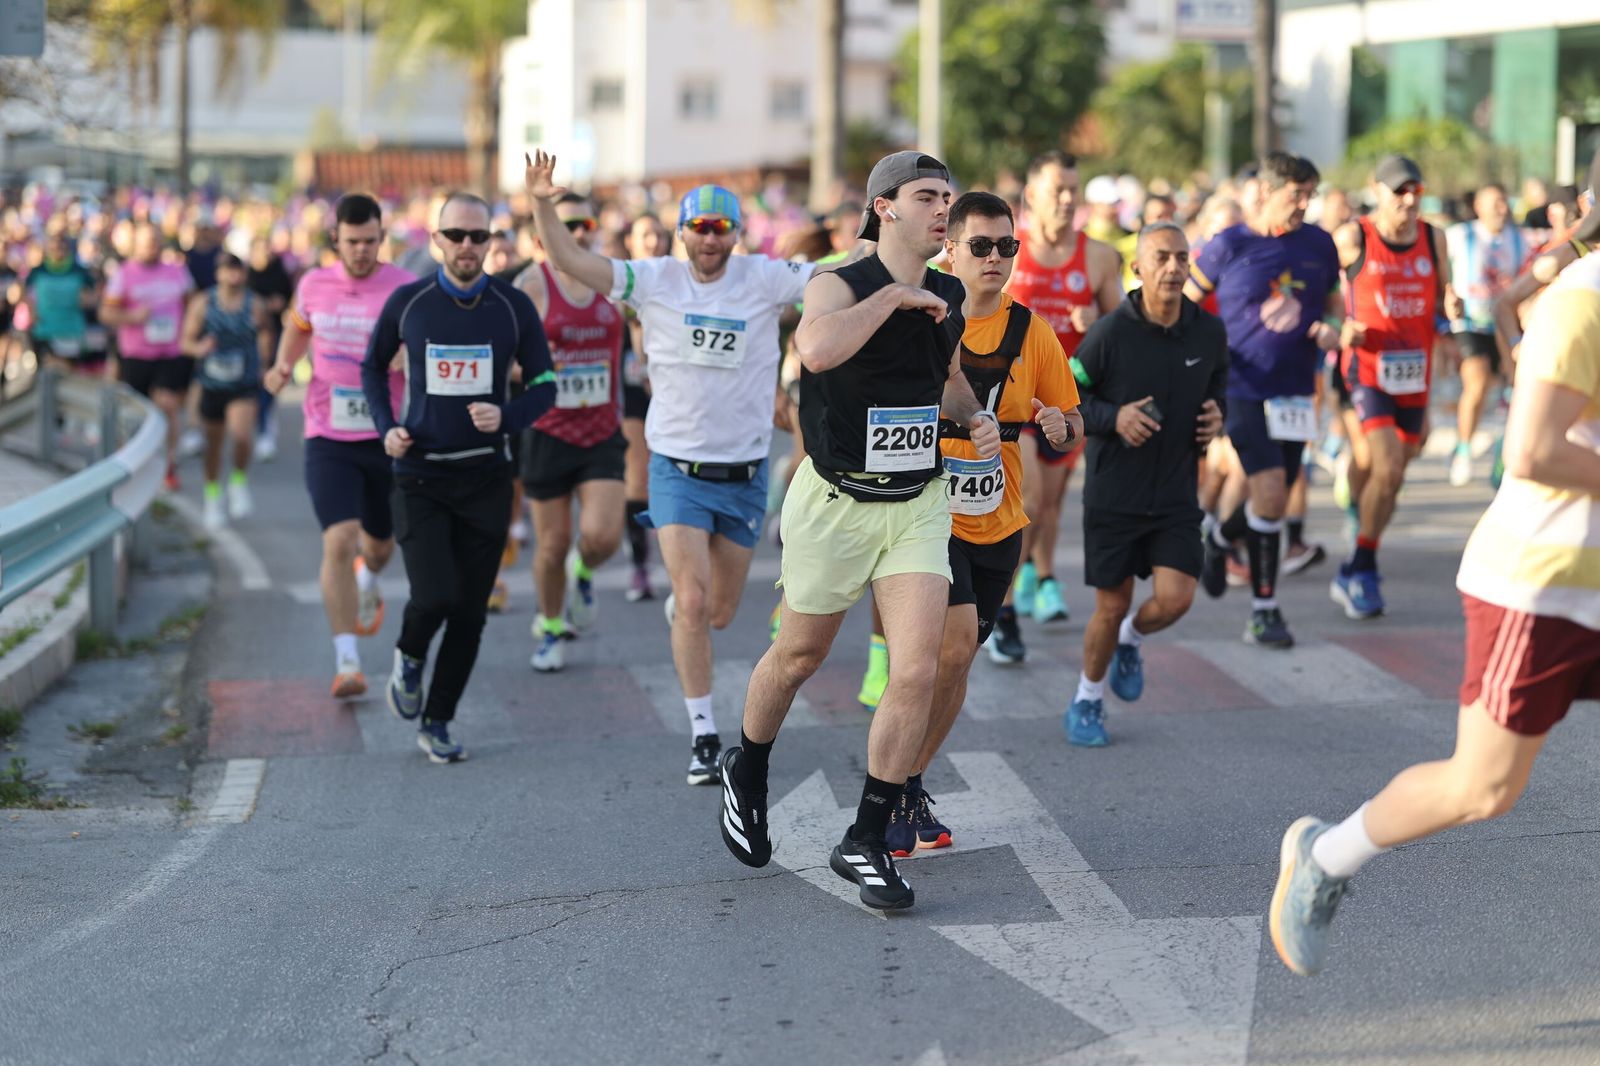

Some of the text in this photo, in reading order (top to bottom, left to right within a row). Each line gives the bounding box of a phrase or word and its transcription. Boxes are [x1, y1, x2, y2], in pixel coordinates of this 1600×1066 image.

[692, 328, 736, 351] 972
[438, 360, 479, 379] 971
[562, 375, 606, 395] 1911
[872, 425, 935, 451] 2208
[950, 469, 1004, 497] 1402
